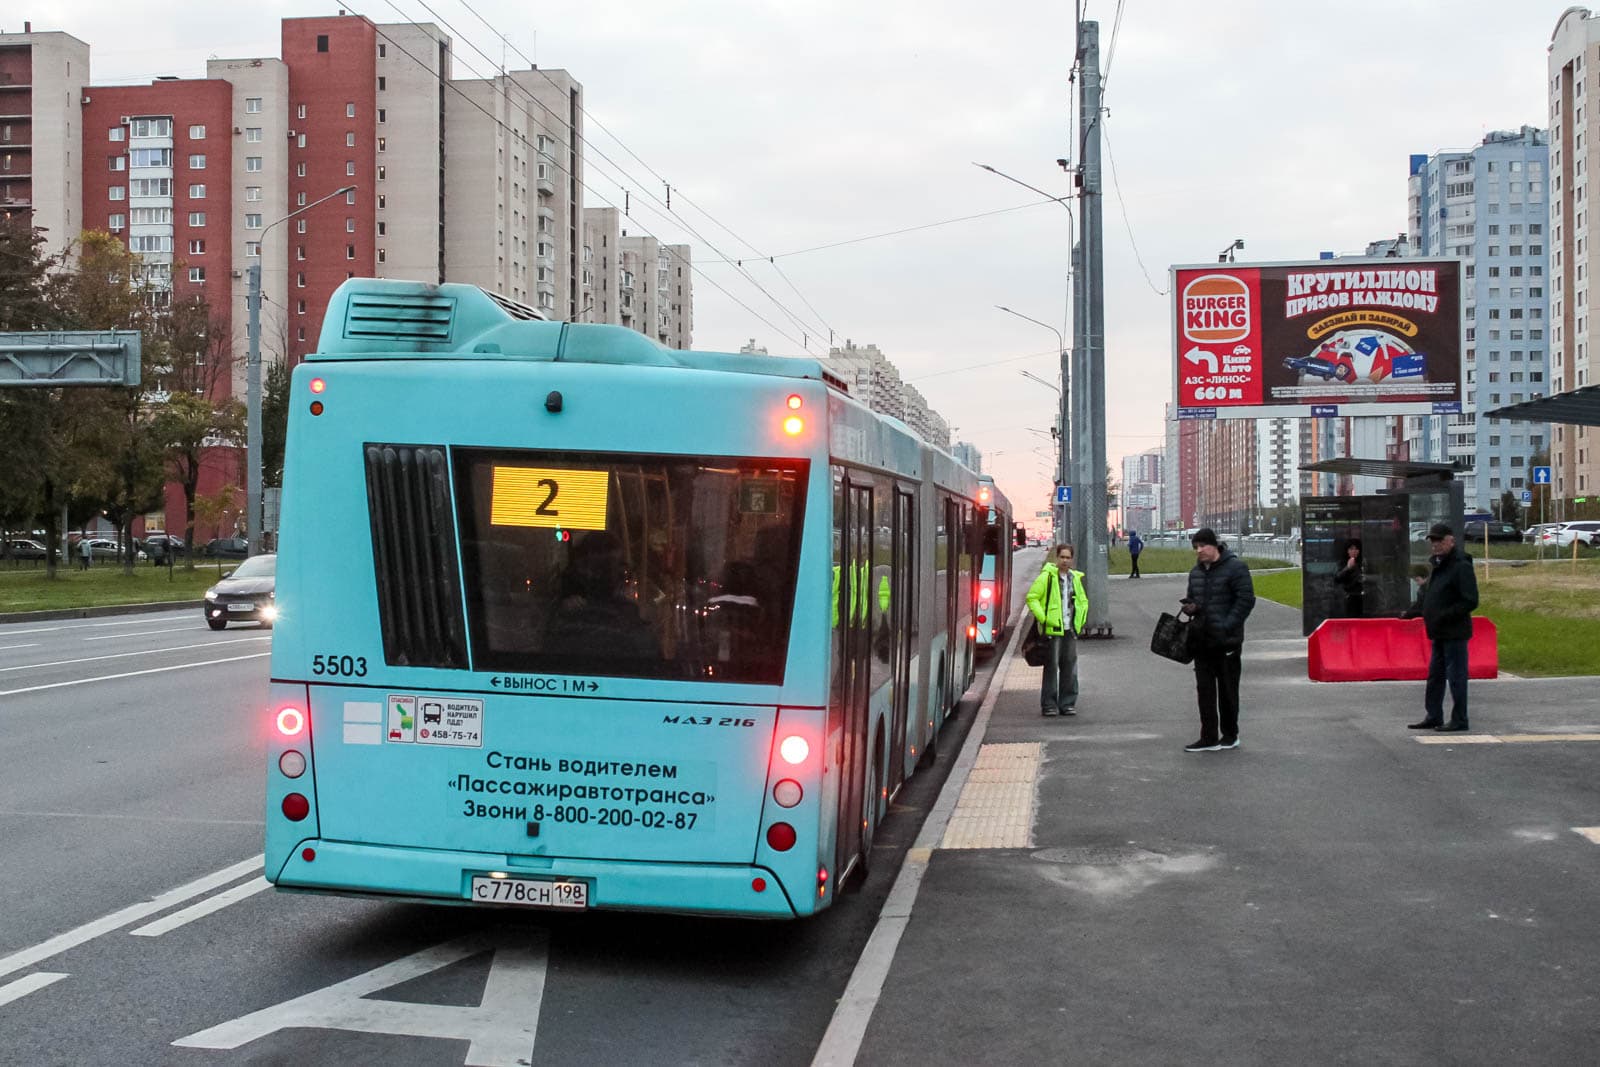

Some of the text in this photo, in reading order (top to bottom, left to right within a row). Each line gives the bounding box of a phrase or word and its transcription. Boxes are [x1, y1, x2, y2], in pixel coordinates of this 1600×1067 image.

[1287, 270, 1436, 297] КРУТИЛЛИОН
[1186, 296, 1247, 311] BURGER
[1286, 291, 1438, 318] ПРИЗОВ КАЖДОМУ
[1187, 310, 1247, 329] KING
[1311, 313, 1412, 335] ЗАЕЗЖАЙ И ЗАБИРАЙ
[1222, 364, 1252, 373] Авто
[1185, 375, 1252, 385] АЗС «ЛИНОС»
[1194, 386, 1243, 400] 660 м
[535, 478, 559, 516] 2
[312, 655, 368, 677] 5503
[504, 676, 585, 692] ВЫНОС 1 М
[447, 703, 480, 712] ВОДИТЕЛЬ
[447, 711, 478, 719] НАРУШИЛ
[662, 715, 758, 727] МАЗ 216
[432, 730, 478, 740] 458-75-74
[486, 751, 678, 779] Стань водителем
[448, 774, 715, 805] «Пассажиравтотранса»
[463, 800, 698, 830] Звони 8-800-200-02-87
[554, 884, 582, 899] 198
